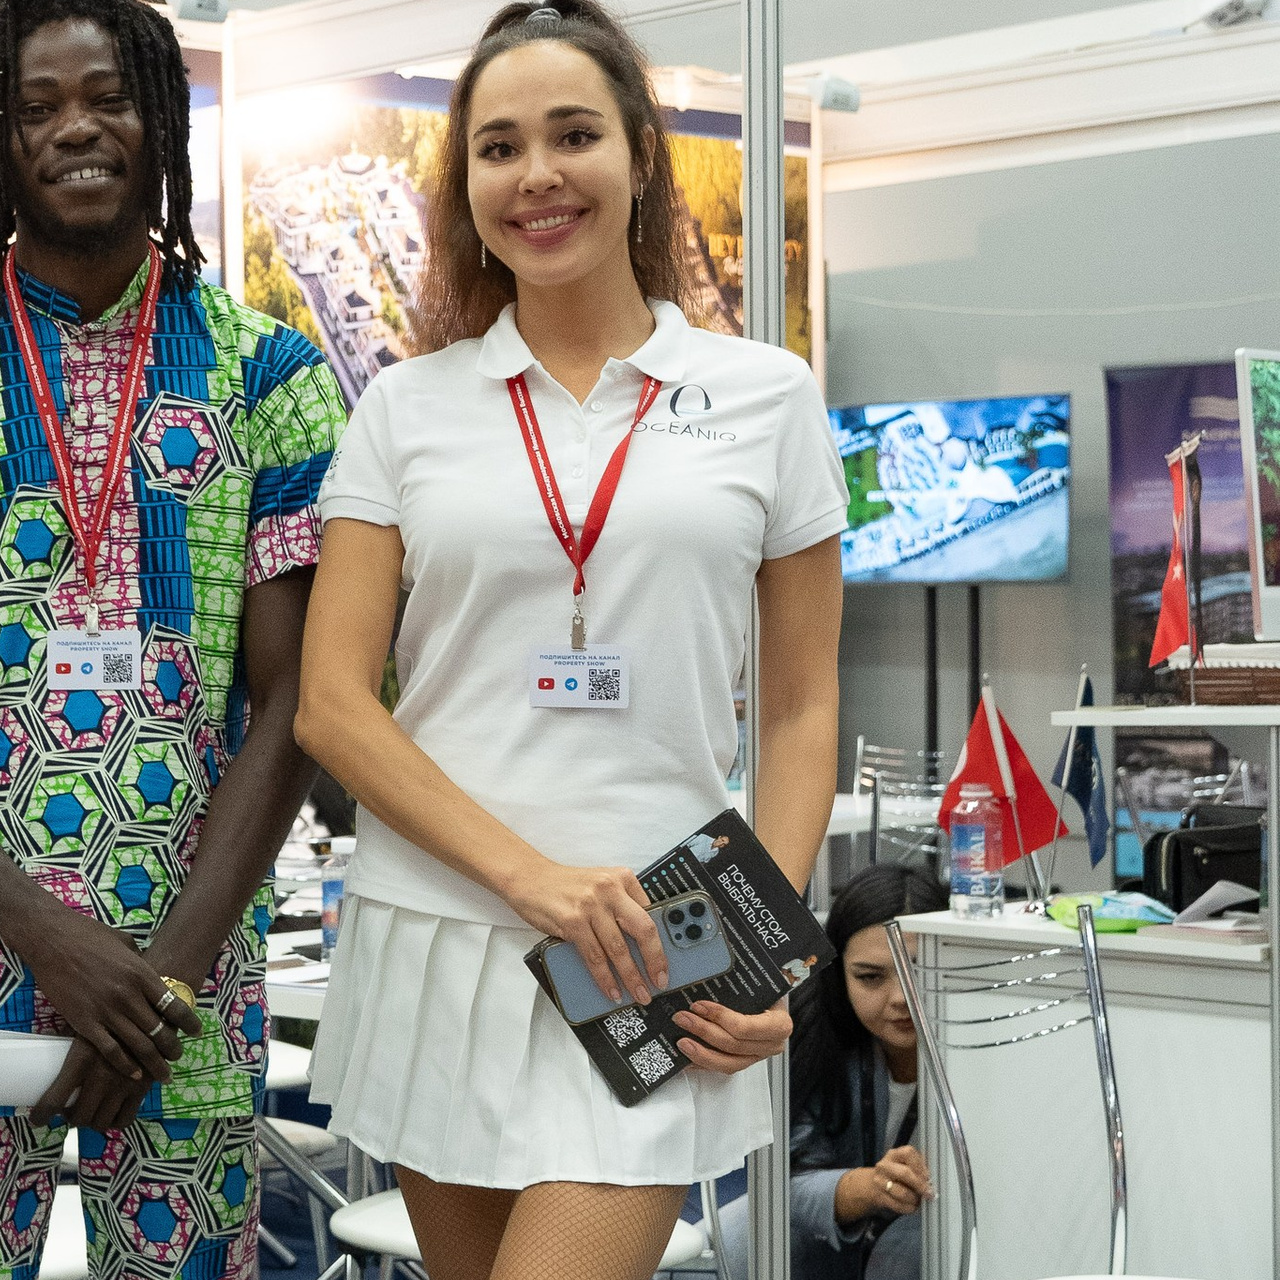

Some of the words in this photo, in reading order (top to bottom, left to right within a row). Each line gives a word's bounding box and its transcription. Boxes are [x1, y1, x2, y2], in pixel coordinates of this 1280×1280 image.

[631, 421, 736, 442] OCEANIQ
[717, 872, 757, 924] ВЫБРАТЬ
[753, 919, 779, 950] НАС?
[726, 864, 765, 911] ПОЧЕМУ
[759, 906, 790, 944] СТОИТ
